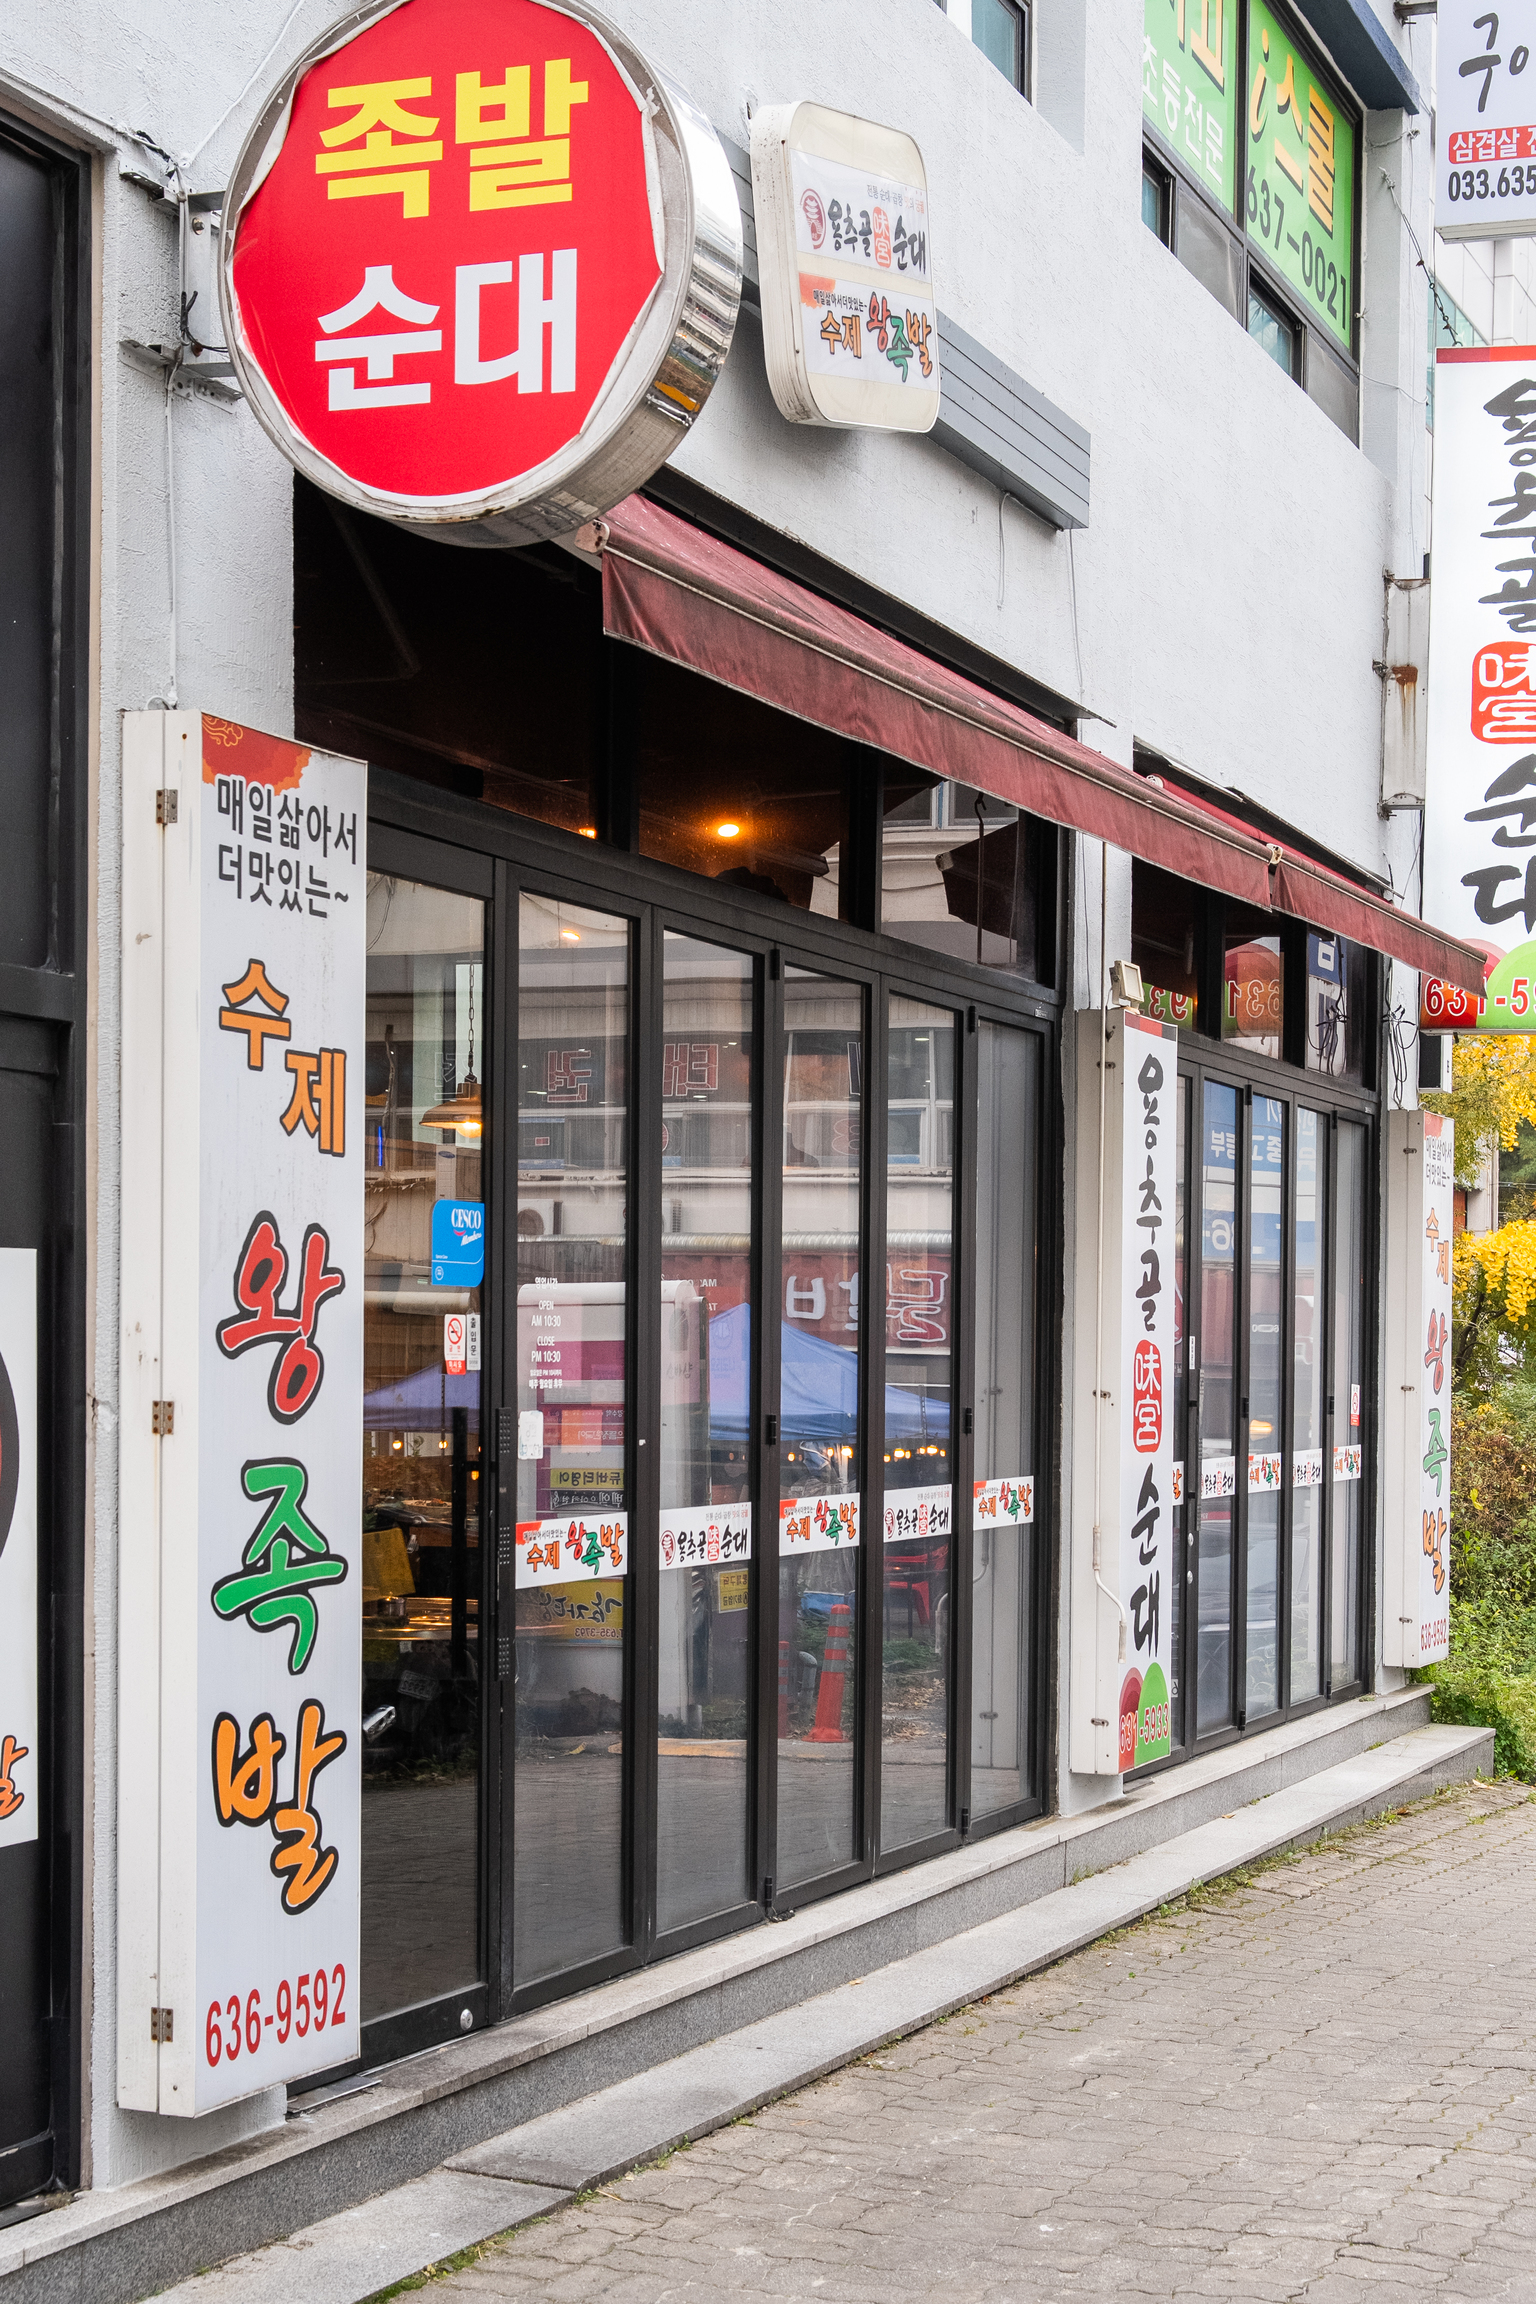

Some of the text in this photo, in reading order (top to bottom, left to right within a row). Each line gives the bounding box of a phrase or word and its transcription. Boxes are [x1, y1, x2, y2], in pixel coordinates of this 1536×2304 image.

[1142, 33, 1224, 187] 초등전문
[314, 58, 590, 219] 족발
[1452, 128, 1521, 163] 삼겹살
[892, 214, 926, 275] 순대
[1246, 165, 1347, 331] 637-0021
[314, 248, 579, 412] 순대
[820, 290, 933, 383] 수제 왕족발
[216, 777, 357, 866] 매일삶아서
[218, 843, 350, 919] 더맛있는~
[451, 1208, 482, 1230] CESCO
[531, 1315, 562, 1327] AM 10:30
[538, 1300, 555, 1311] OPEN
[531, 1350, 562, 1363] PM 10:30
[536, 1336, 556, 1347] CLOSE
[1423, 1207, 1449, 1596] 수제 왕족발
[210, 957, 349, 1917] 수제 왕족발
[786, 1498, 858, 1547] 수제 왕족발
[928, 1503, 949, 1533] 순대
[978, 1496, 997, 1520] 수제
[526, 1520, 625, 1576] 수제 왕족발
[720, 1523, 748, 1559] 순대
[1130, 1461, 1161, 1659] 순대
[1420, 1617, 1447, 1651] 636-9592
[1119, 1702, 1169, 1754] 631-5933
[205, 1962, 346, 2068] 636-9592
